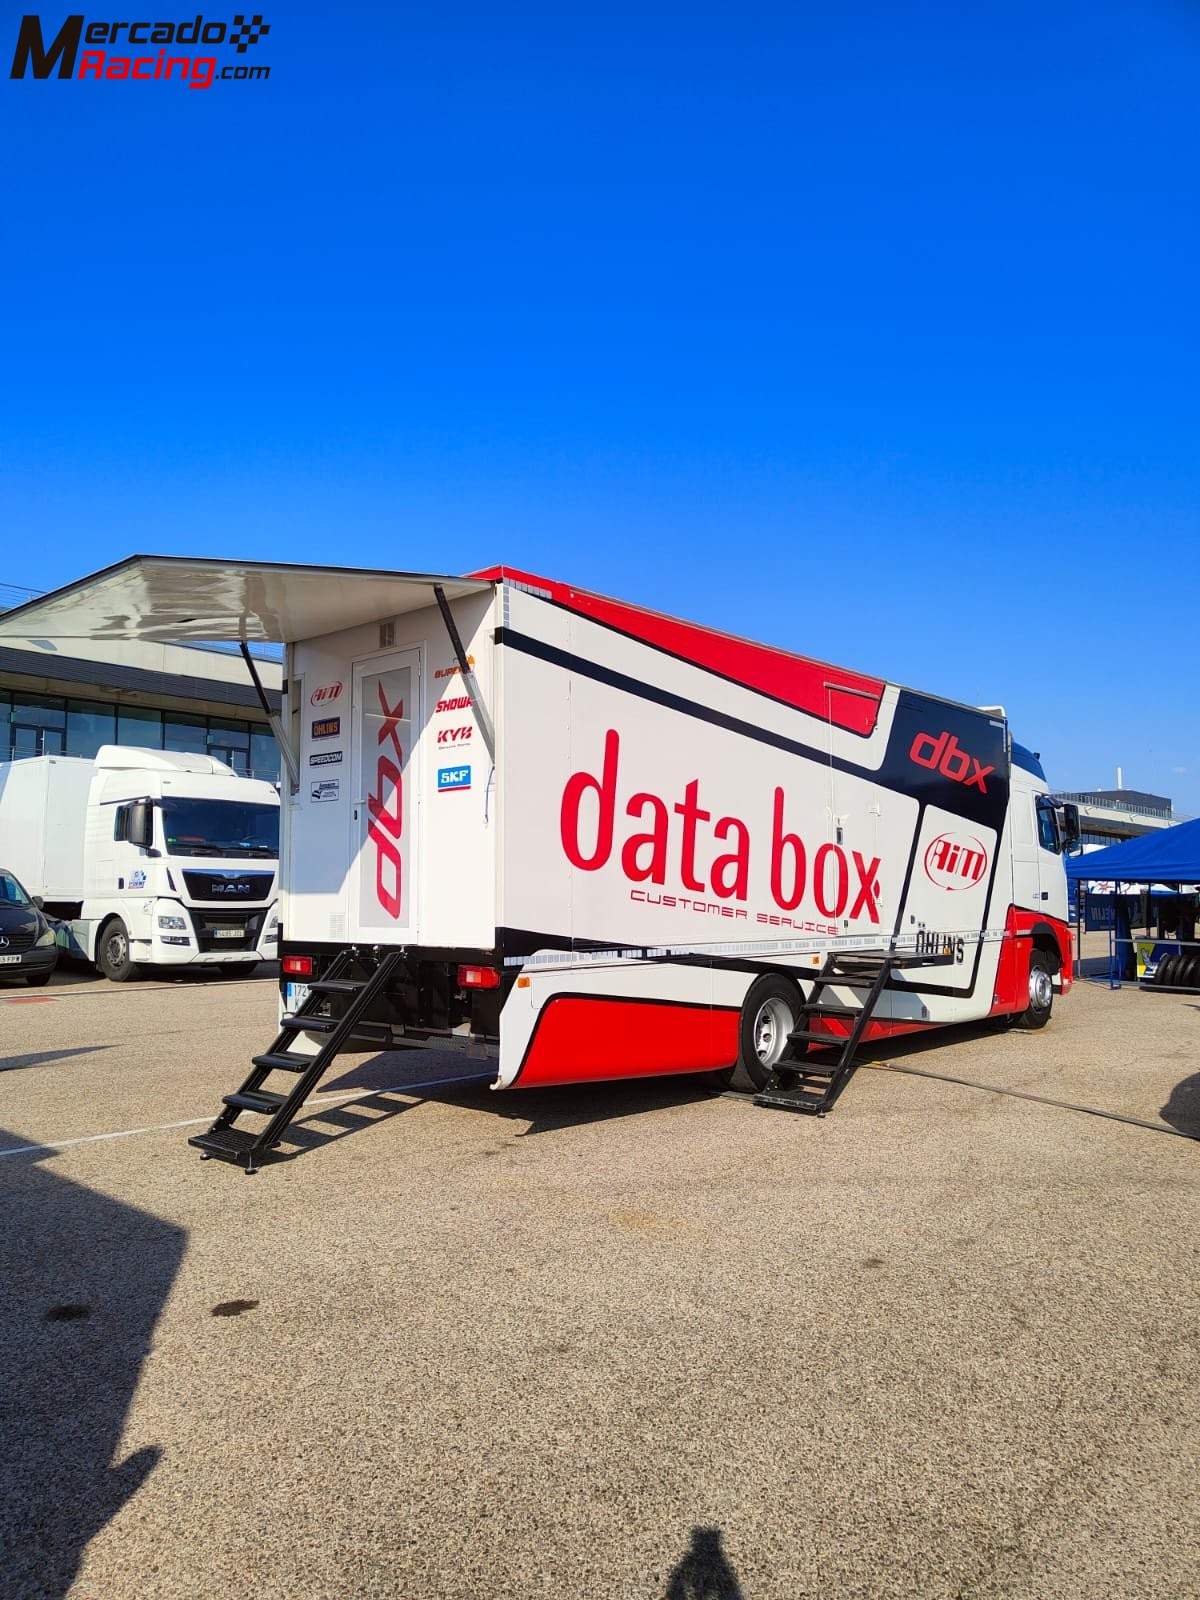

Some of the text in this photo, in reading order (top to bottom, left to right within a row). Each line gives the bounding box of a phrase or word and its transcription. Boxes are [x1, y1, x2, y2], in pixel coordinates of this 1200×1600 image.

[437, 726, 473, 744] KYB
[310, 752, 343, 765] SPEEDCOM
[909, 731, 997, 794] dbx
[440, 769, 469, 784] SKF
[560, 728, 882, 924] data box
[211, 883, 250, 893] MAN
[630, 889, 839, 936] CUSTOMER SERVICE
